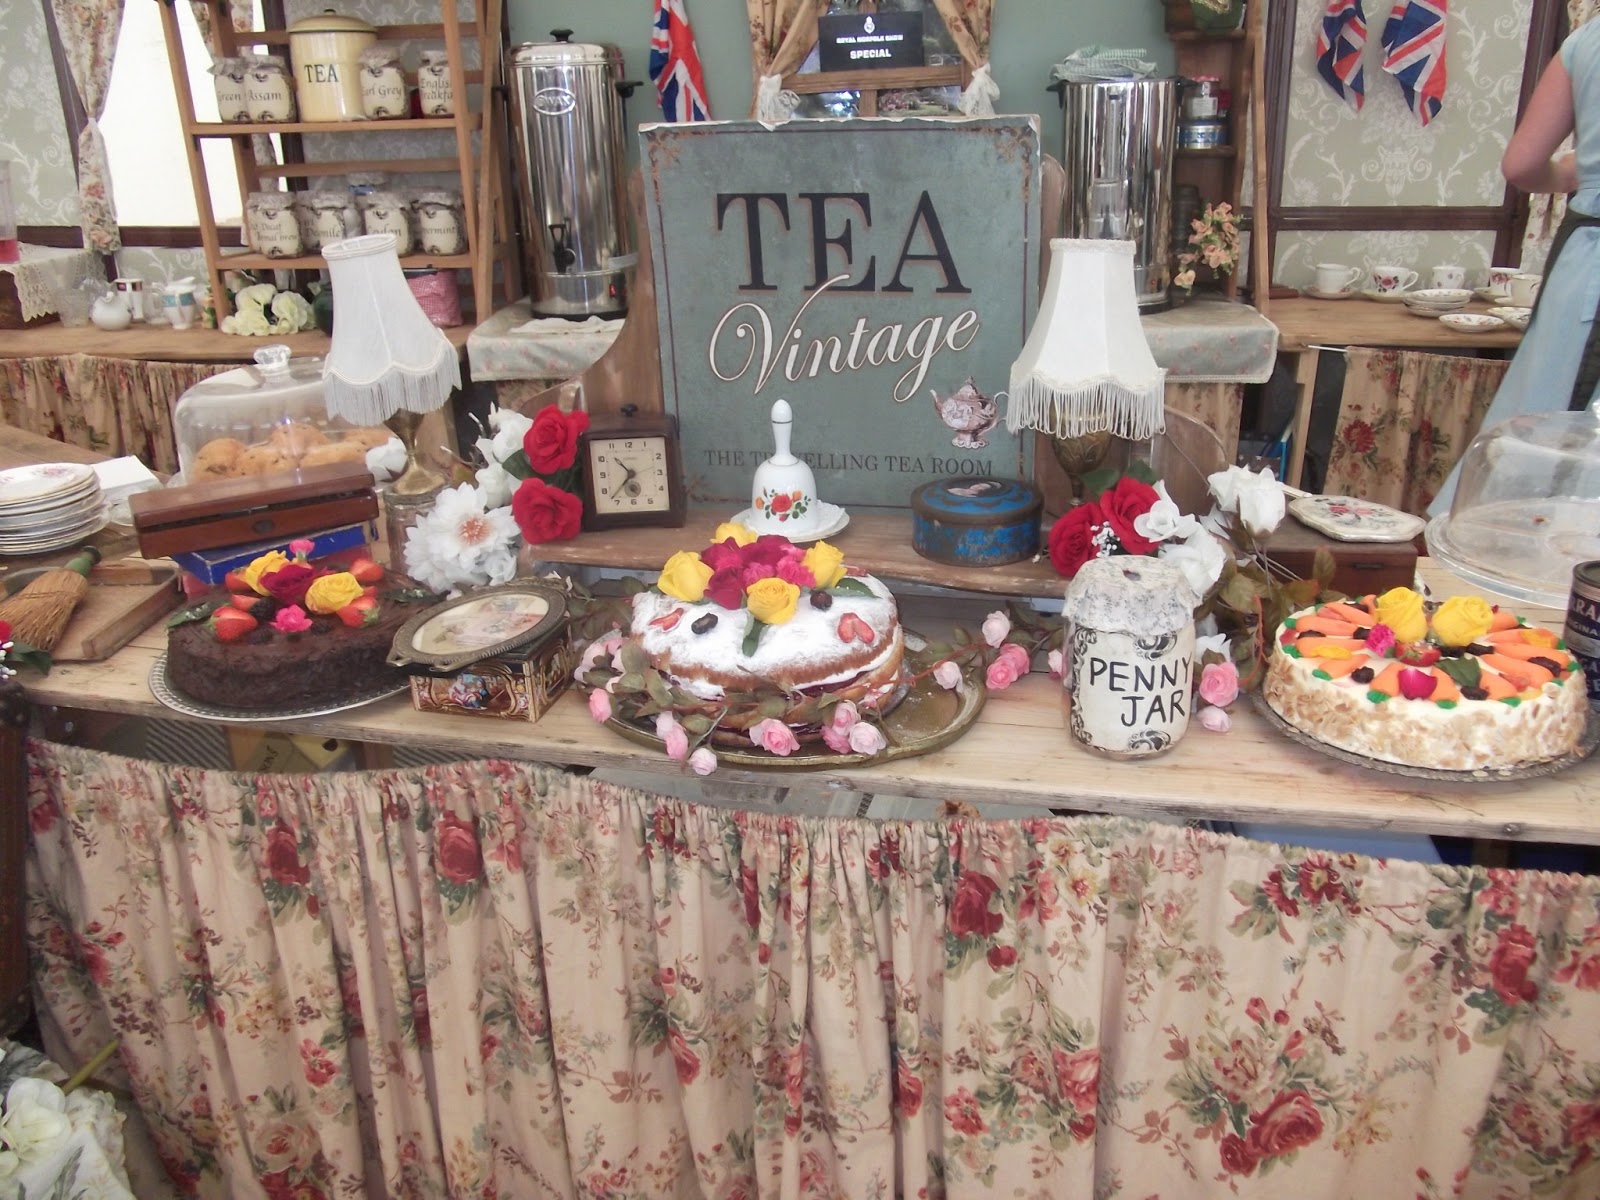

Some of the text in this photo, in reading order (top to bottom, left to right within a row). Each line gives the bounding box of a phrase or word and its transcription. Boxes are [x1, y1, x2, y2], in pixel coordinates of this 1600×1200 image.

[850, 48, 891, 59] SPECIAL
[304, 64, 339, 83] TEA
[248, 90, 281, 100] Assam
[716, 190, 972, 294] TEA
[709, 274, 980, 402] Vintage
[704, 450, 992, 476] THE TELLING TEA ROOM
[1090, 652, 1192, 692] PENNY
[1121, 690, 1186, 727] JAR
